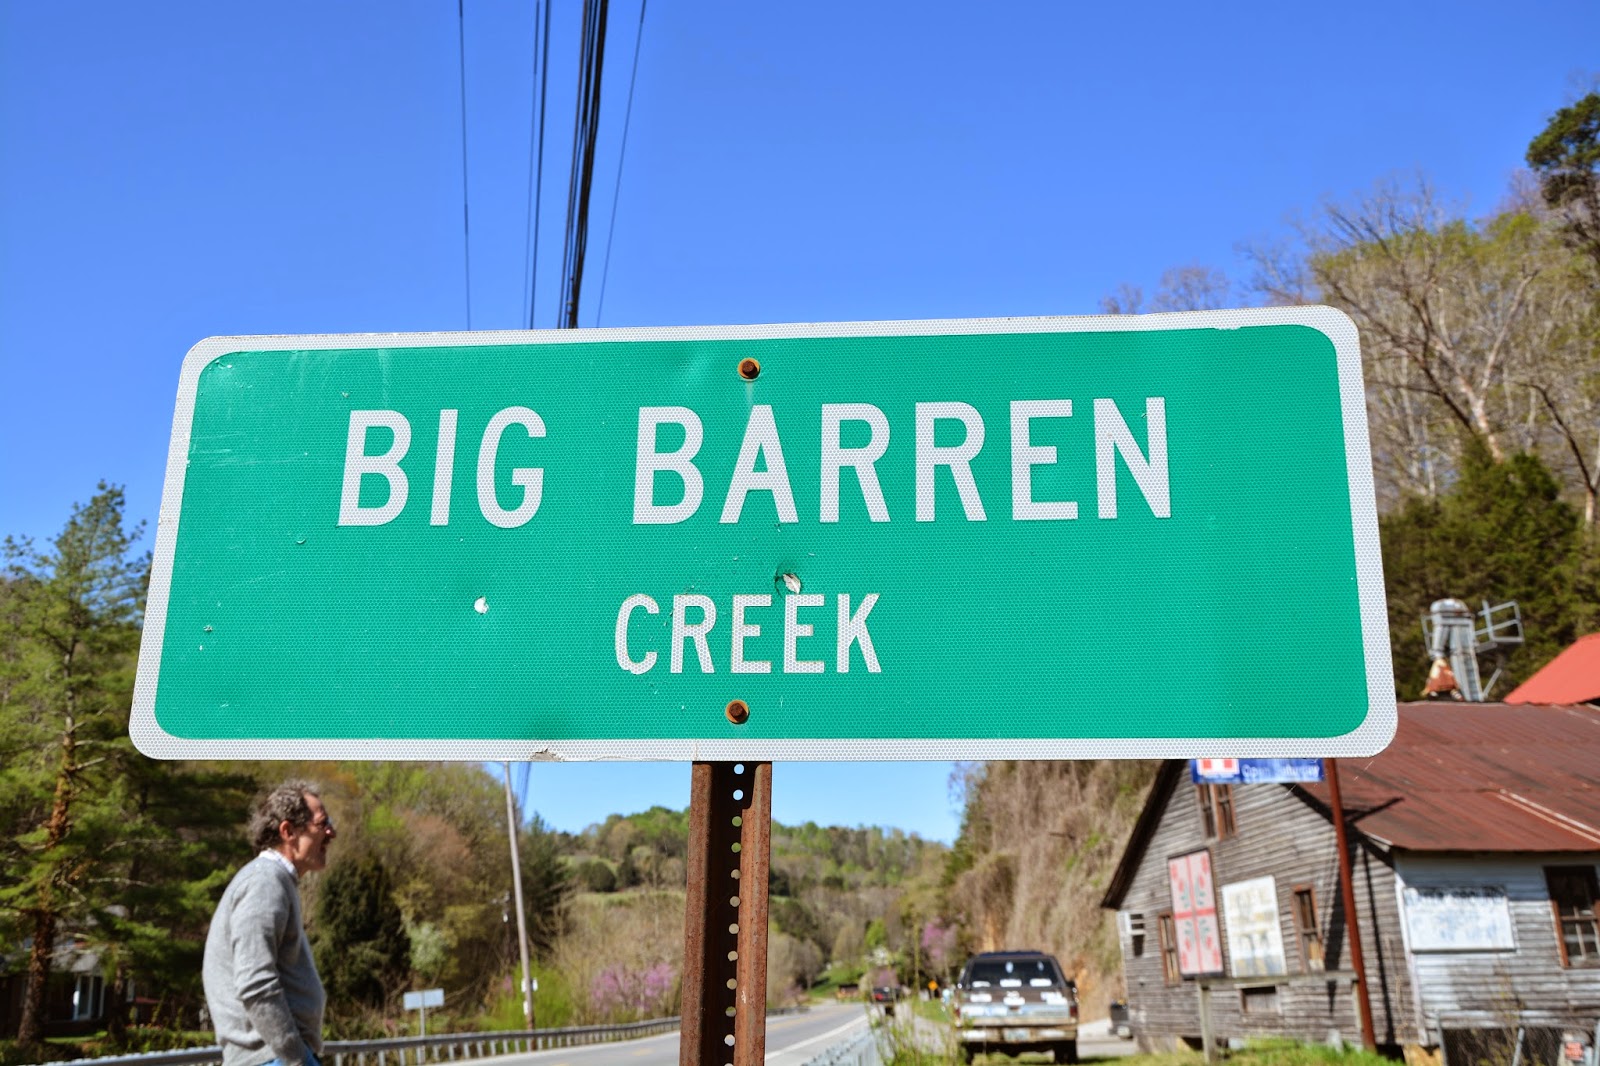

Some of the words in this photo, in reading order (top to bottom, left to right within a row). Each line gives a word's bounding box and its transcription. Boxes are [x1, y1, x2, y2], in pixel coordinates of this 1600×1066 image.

[337, 405, 548, 528] BIG
[632, 397, 1172, 524] BARREN
[614, 593, 881, 676] CREEK
